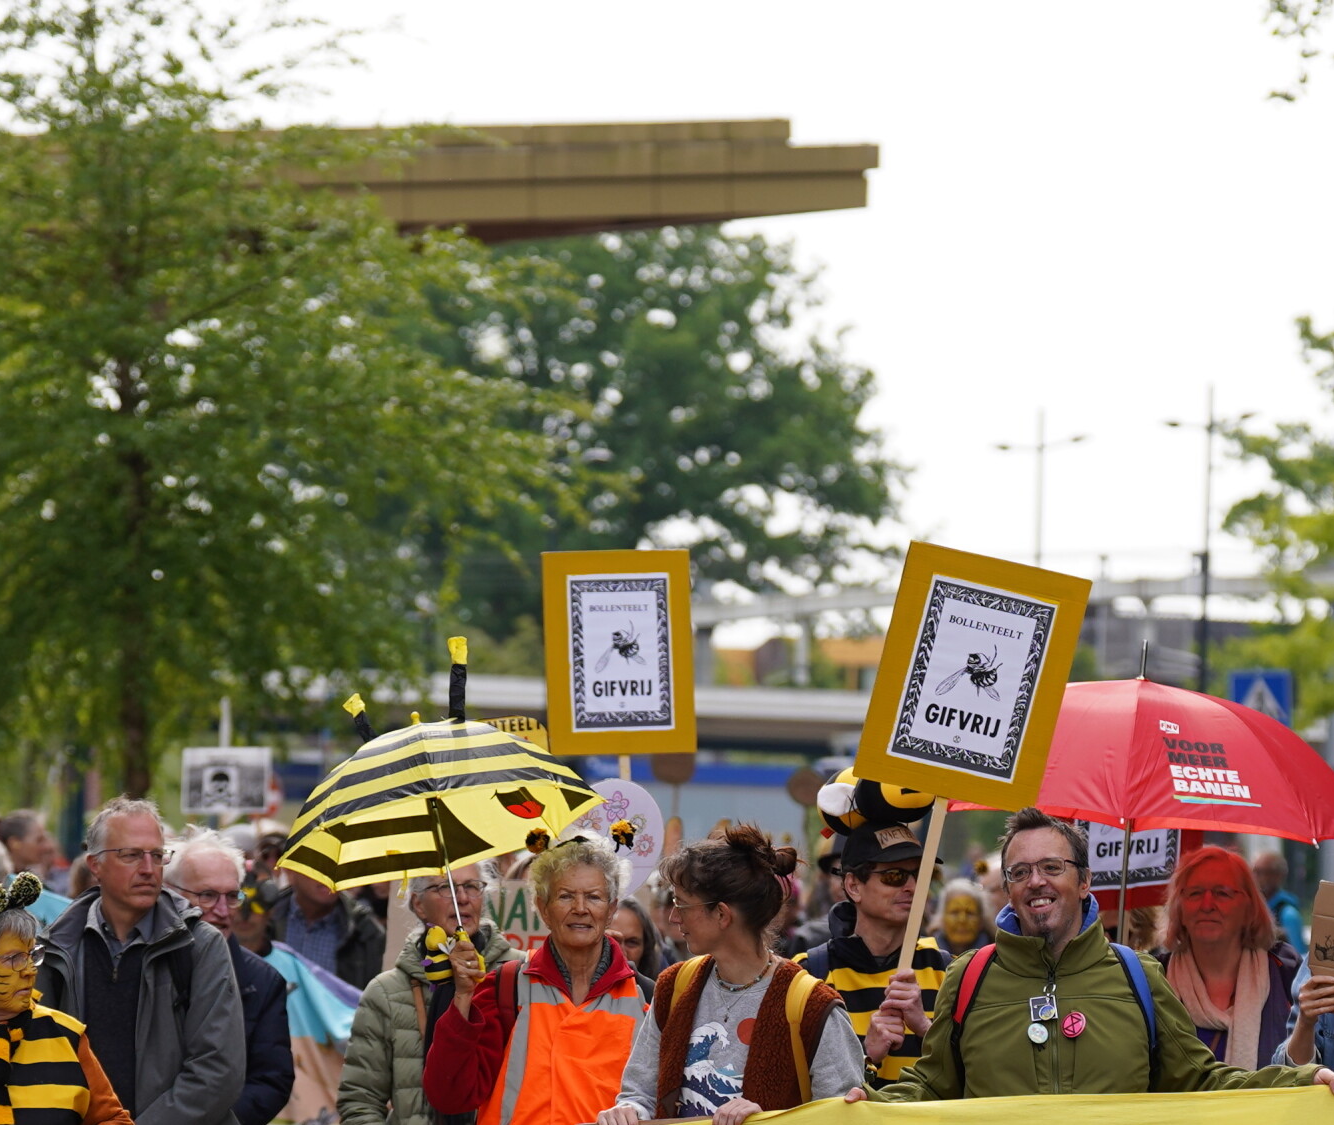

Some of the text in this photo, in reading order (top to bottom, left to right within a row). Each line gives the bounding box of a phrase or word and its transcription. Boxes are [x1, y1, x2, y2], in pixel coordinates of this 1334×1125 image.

[589, 604, 649, 613] BOLLENTEELT
[948, 614, 1024, 640] BOLLENTEELT
[592, 679, 653, 697] GIFVRIJ
[924, 703, 1002, 738] GIFVRIJ
[1160, 722, 1178, 731] FNV
[1162, 736, 1226, 755] VOOR
[1166, 751, 1229, 769] MEER
[1169, 764, 1241, 784] ECHTE
[1172, 778, 1252, 799] BANEN
